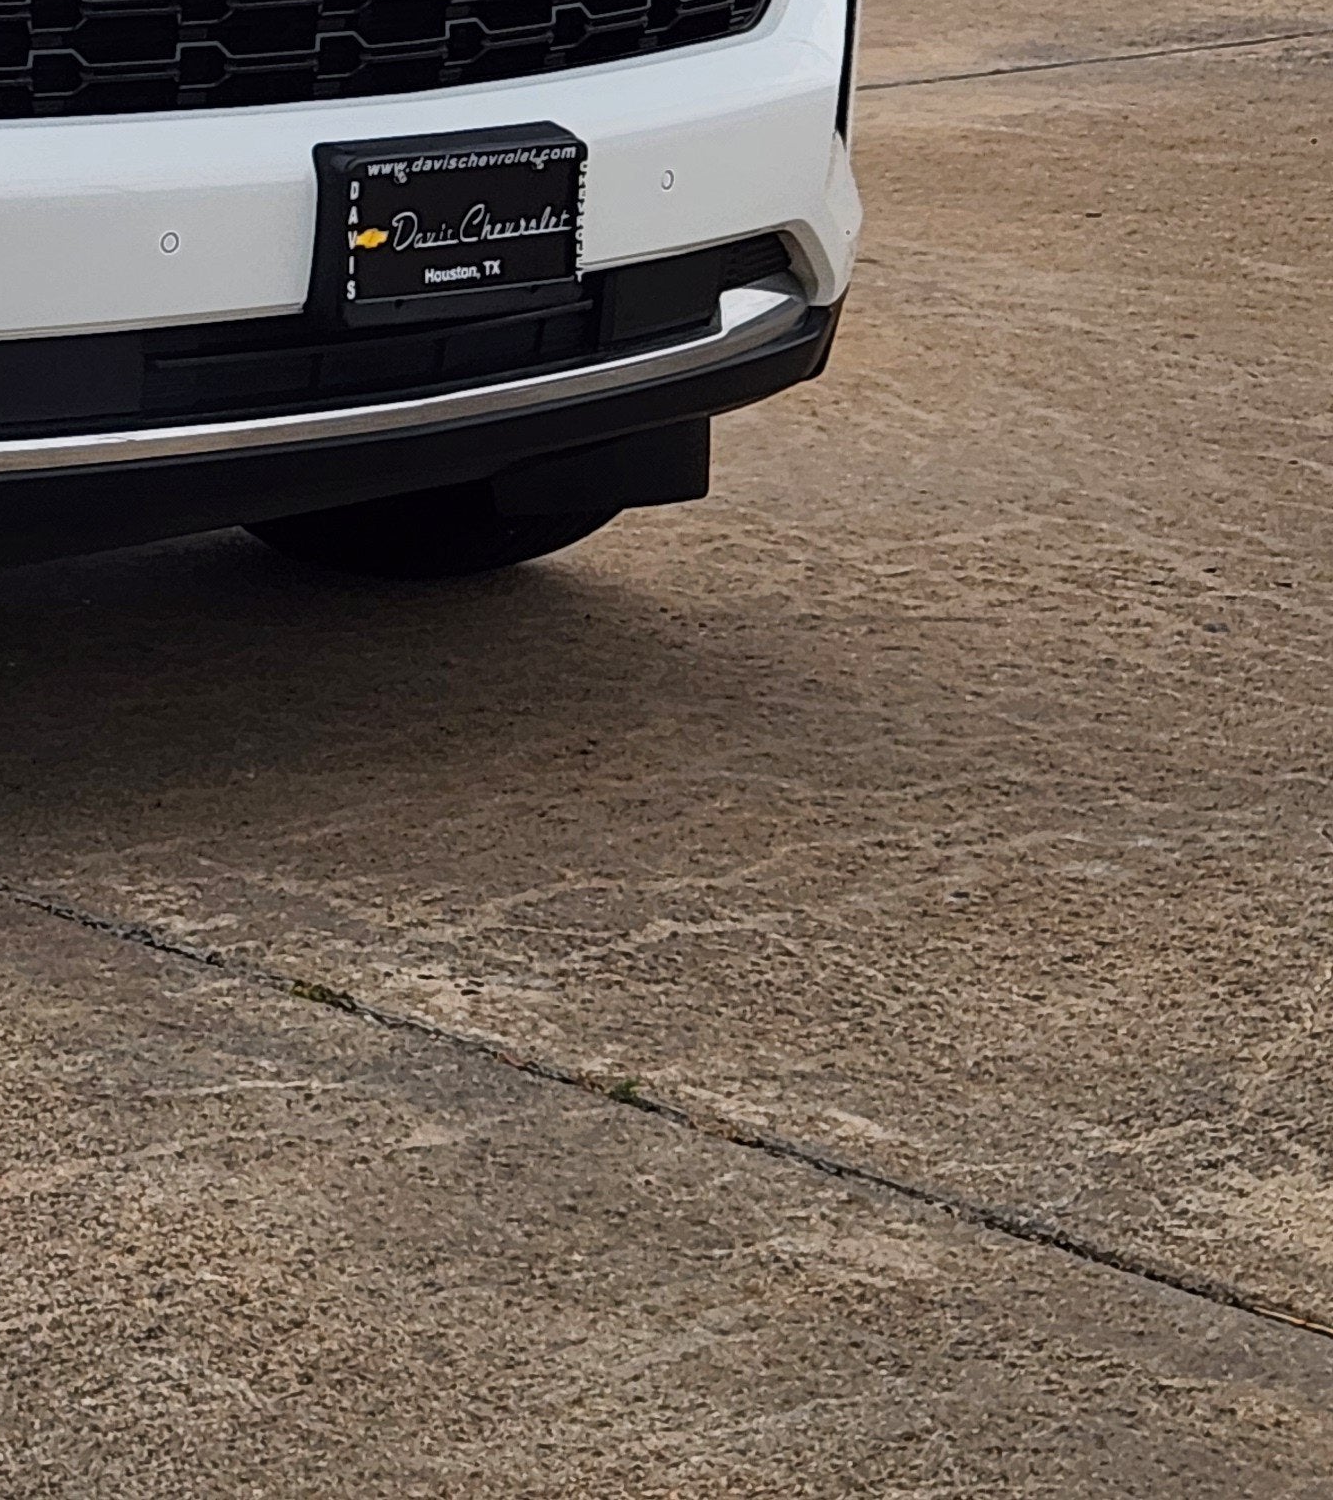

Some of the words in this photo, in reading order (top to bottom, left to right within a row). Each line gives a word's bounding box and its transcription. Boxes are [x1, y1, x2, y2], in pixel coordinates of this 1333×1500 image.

[367, 146, 577, 176] www.davischevrolet.com
[346, 180, 361, 300] DAVIS
[392, 211, 459, 251] Davis
[459, 203, 572, 243] Chevrolet
[424, 265, 481, 284] Houston,
[483, 260, 501, 275] TX
